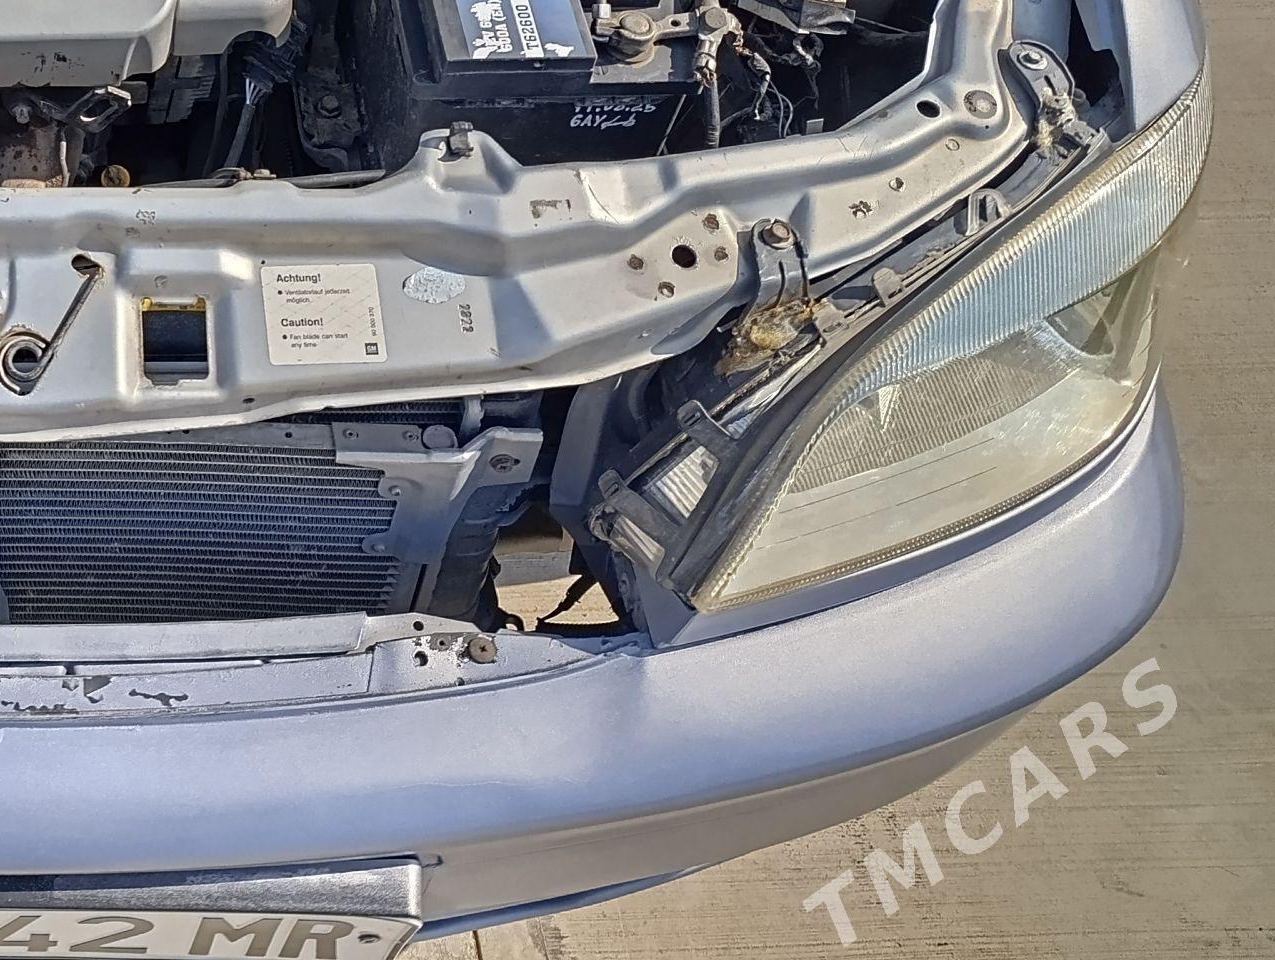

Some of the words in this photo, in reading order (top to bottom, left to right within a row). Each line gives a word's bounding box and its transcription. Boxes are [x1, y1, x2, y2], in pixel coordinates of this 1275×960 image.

[515, 4, 539, 51] T62600
[276, 272, 322, 284] Achtung!
[280, 317, 324, 327] Caution!
[189, 917, 355, 960] MR
